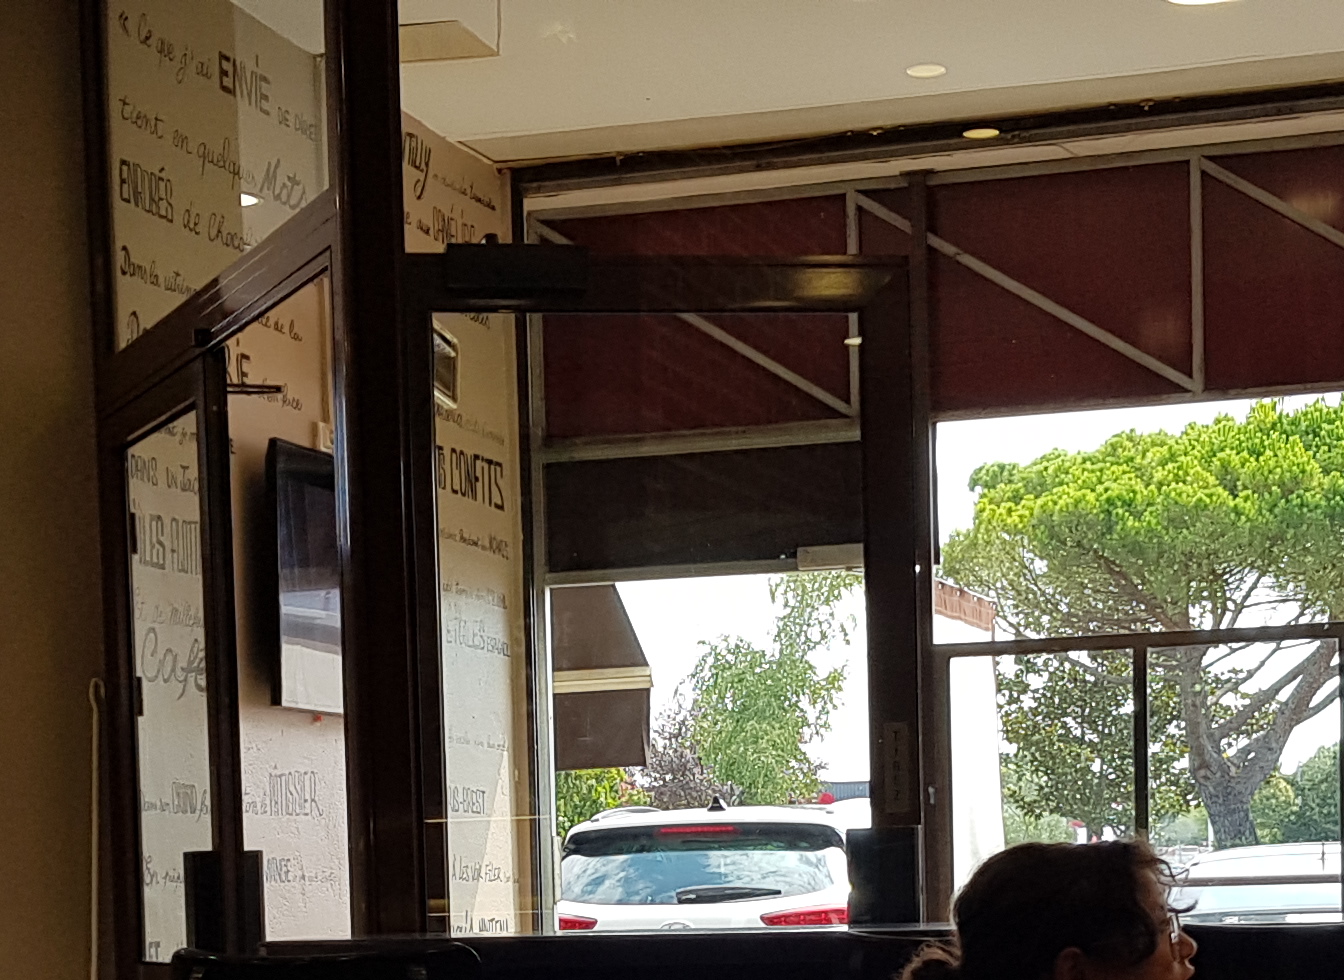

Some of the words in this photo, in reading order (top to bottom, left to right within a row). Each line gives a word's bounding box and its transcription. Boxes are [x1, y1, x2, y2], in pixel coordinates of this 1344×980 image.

[118, 95, 164, 140] tient
[172, 128, 192, 155] en
[182, 201, 201, 236] de
